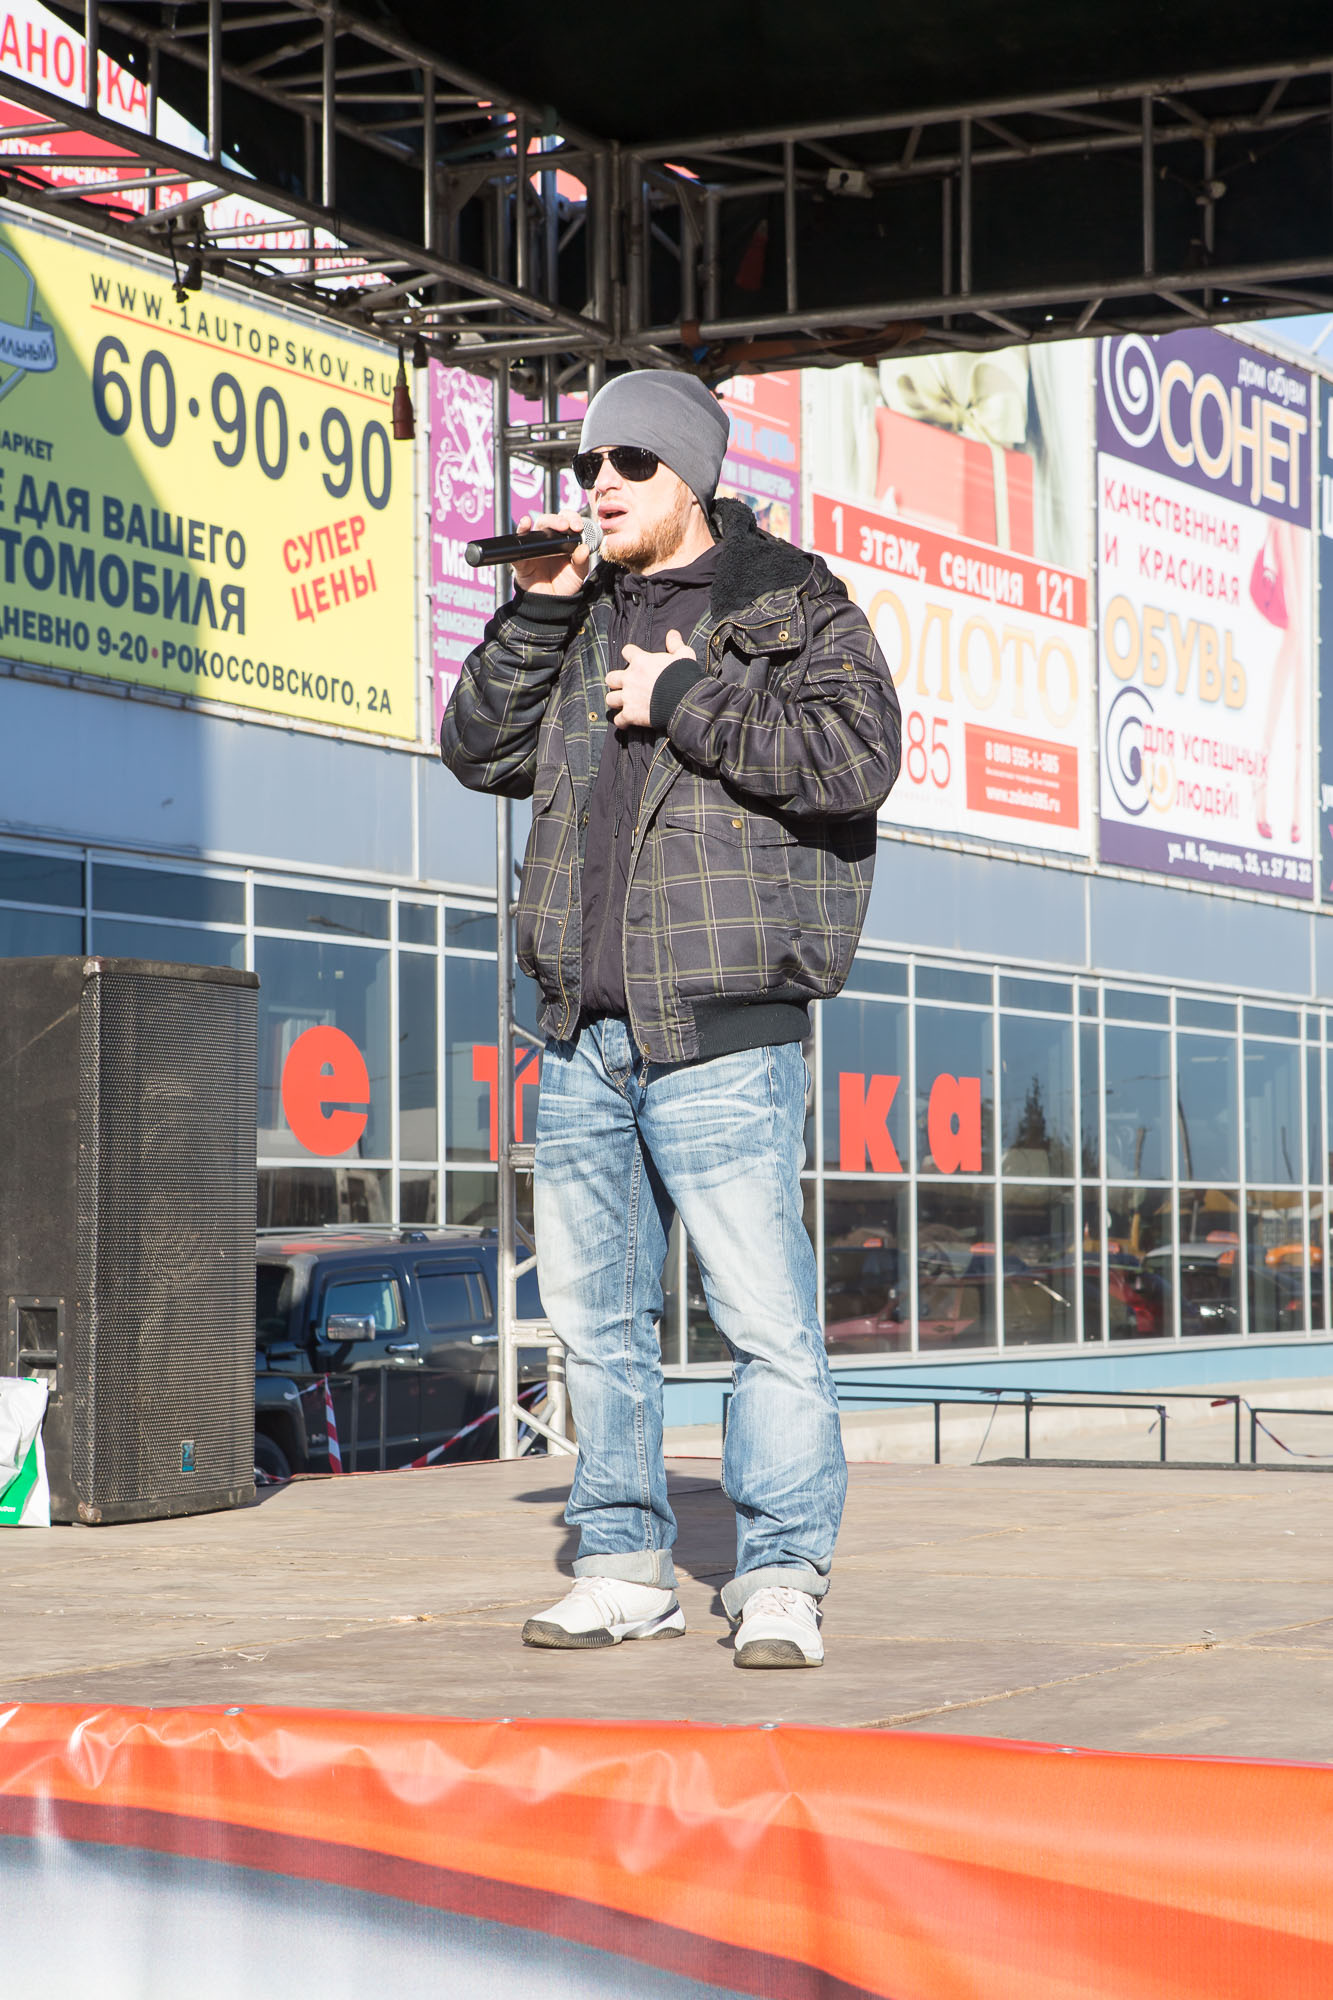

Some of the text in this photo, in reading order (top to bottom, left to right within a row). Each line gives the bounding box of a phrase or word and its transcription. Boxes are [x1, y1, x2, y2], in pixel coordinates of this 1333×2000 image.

[90, 272, 393, 397] WWW.1AUTOPSKOV.RU
[1159, 359, 1308, 510] СОНЕТ
[14, 473, 90, 535] ДЛЯ
[102, 494, 247, 571] ВАШЕГО
[282, 514, 367, 576] СУПЕР
[831, 505, 1074, 621] 1 этаж, секция 121
[1104, 475, 1240, 555] КАЧЕСТВЕННАЯ
[1104, 531, 1240, 607] И КРАСИВАЯ
[0, 526, 247, 636] ТОМОБИЛЯ
[291, 558, 378, 624] ЦЕНЫ
[0, 604, 90, 653] НЕВНО
[97, 625, 148, 665] 9-20
[161, 640, 361, 714] РОКОССОВСКОГО,
[367, 685, 392, 715] 2А
[834, 574, 1080, 729] ОЛОТО
[1103, 593, 1248, 711] ОБУВЬ
[1142, 722, 1269, 780] ДЛЯ УСПЕШНЫХ
